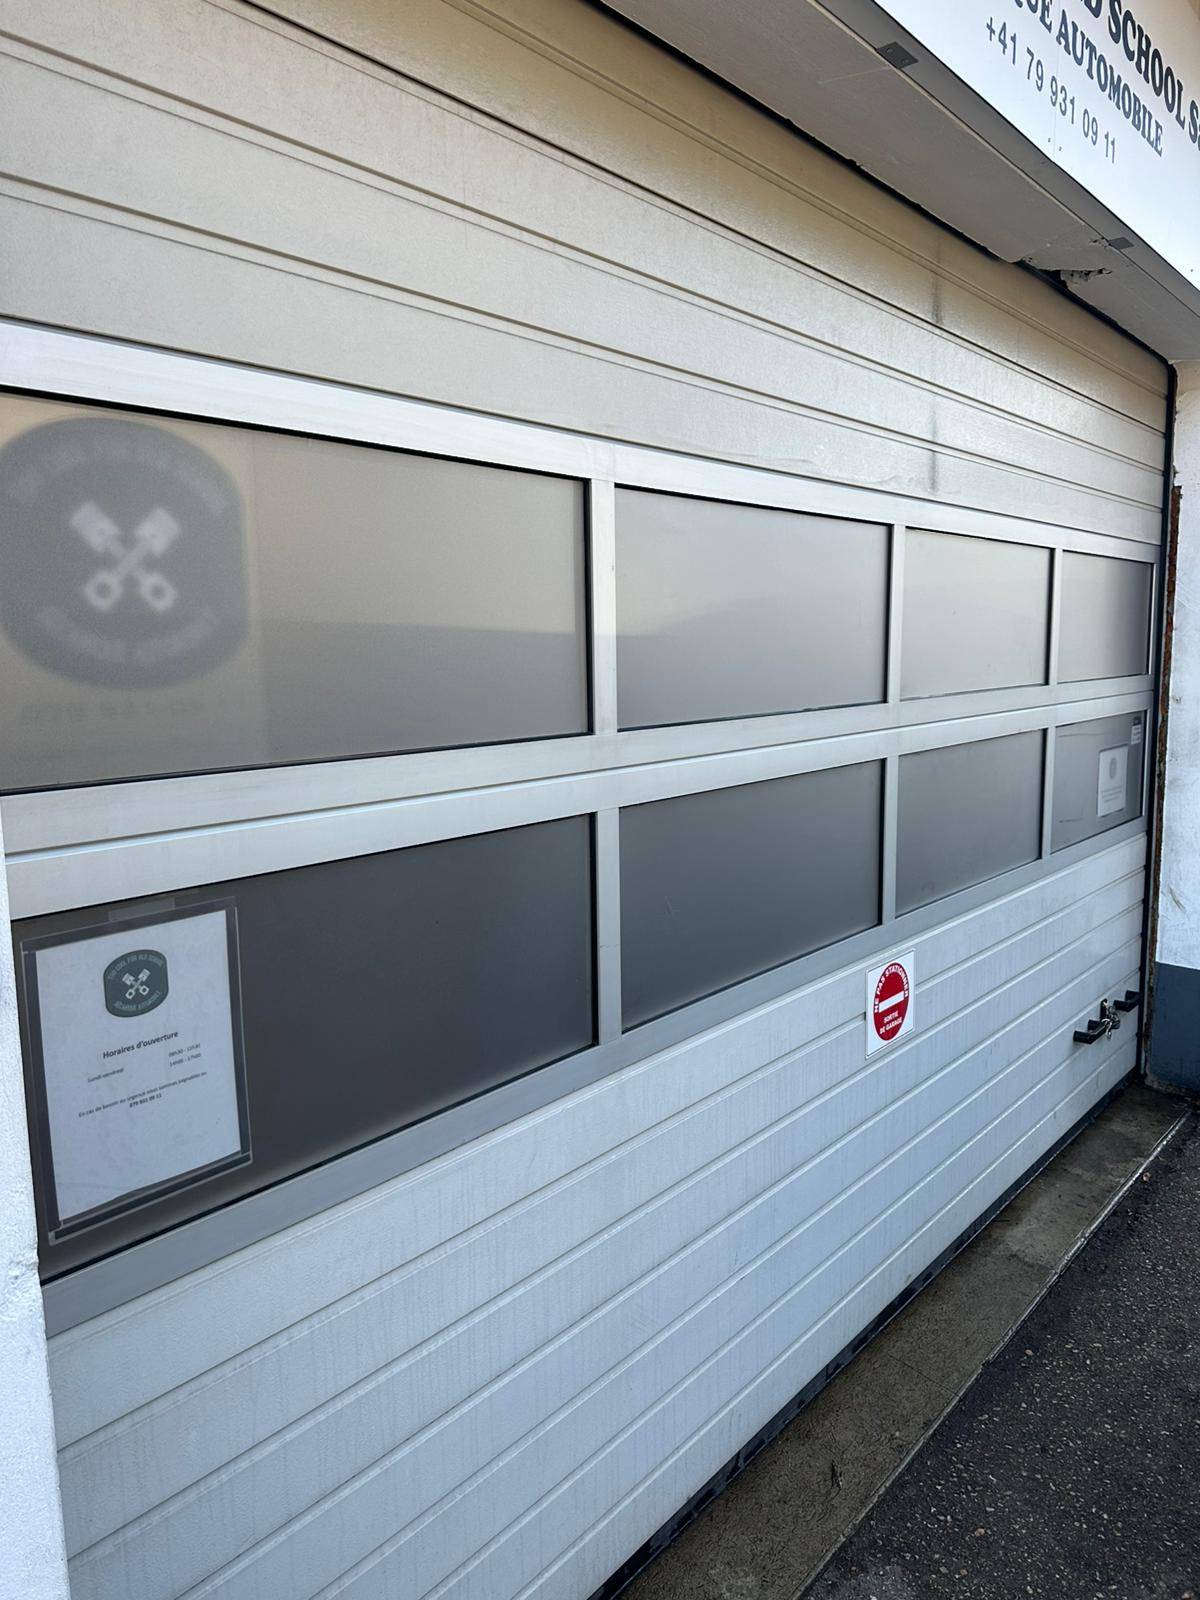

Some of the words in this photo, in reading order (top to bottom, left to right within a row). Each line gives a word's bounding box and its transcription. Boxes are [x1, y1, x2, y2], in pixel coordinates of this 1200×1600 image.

[986, 17, 1016, 65] +41
[1027, 46, 1044, 92] 79
[1050, 75, 1075, 125] 931
[1082, 108, 1098, 146] 09
[1104, 131, 1116, 164] 11
[1056, 9, 1163, 157] AUTOMOBILE
[1108, 0, 1186, 130] SCHOOL
[1189, 99, 1200, 151] S
[103, 1044, 135, 1059] Horaires
[136, 1031, 178, 1049] d'ouverture
